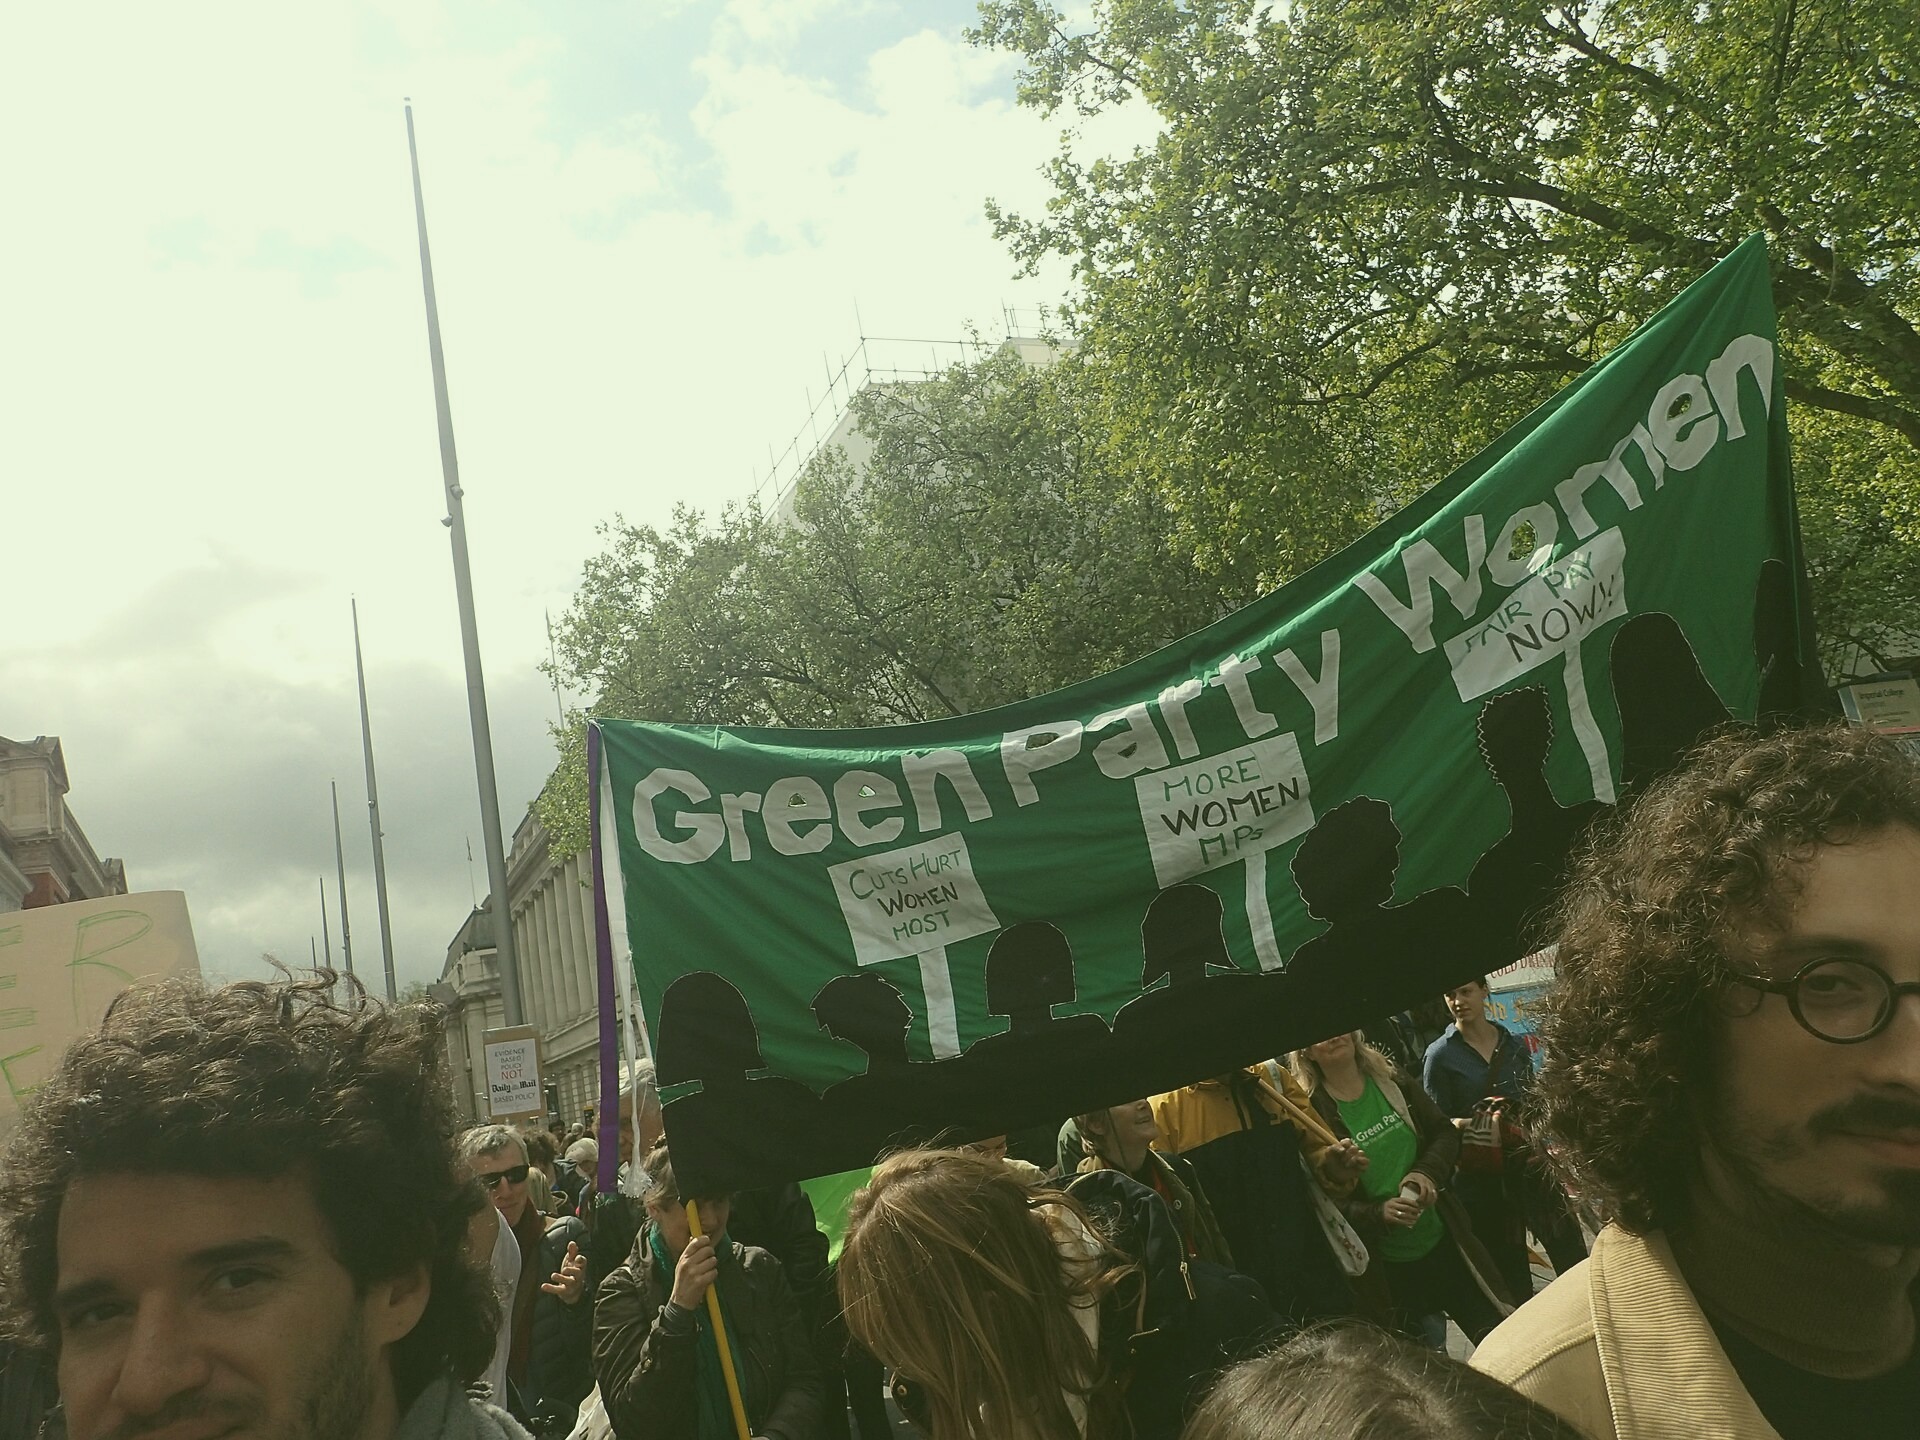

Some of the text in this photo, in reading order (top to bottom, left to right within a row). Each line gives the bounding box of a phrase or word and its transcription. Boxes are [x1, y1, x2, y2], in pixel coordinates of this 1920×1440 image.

[632, 333, 1774, 865] Green Party Women
[1464, 551, 1595, 653] FAIR PAY
[1505, 574, 1615, 663] NOW!!
[1163, 756, 1261, 801] MORE
[1160, 777, 1300, 836] WOMEN
[1198, 825, 1264, 865] MPs
[909, 849, 961, 881] HURT
[876, 881, 959, 917] WOMEN
[892, 909, 951, 941] MOST
[494, 1047, 525, 1057] EVIDENCE
[500, 1055, 522, 1063] BASED
[491, 1080, 537, 1093] Daily Mail
[501, 1069, 523, 1080] NOT
[494, 1092, 536, 1103] BASED POLICY
[1355, 1122, 1383, 1142] Green
